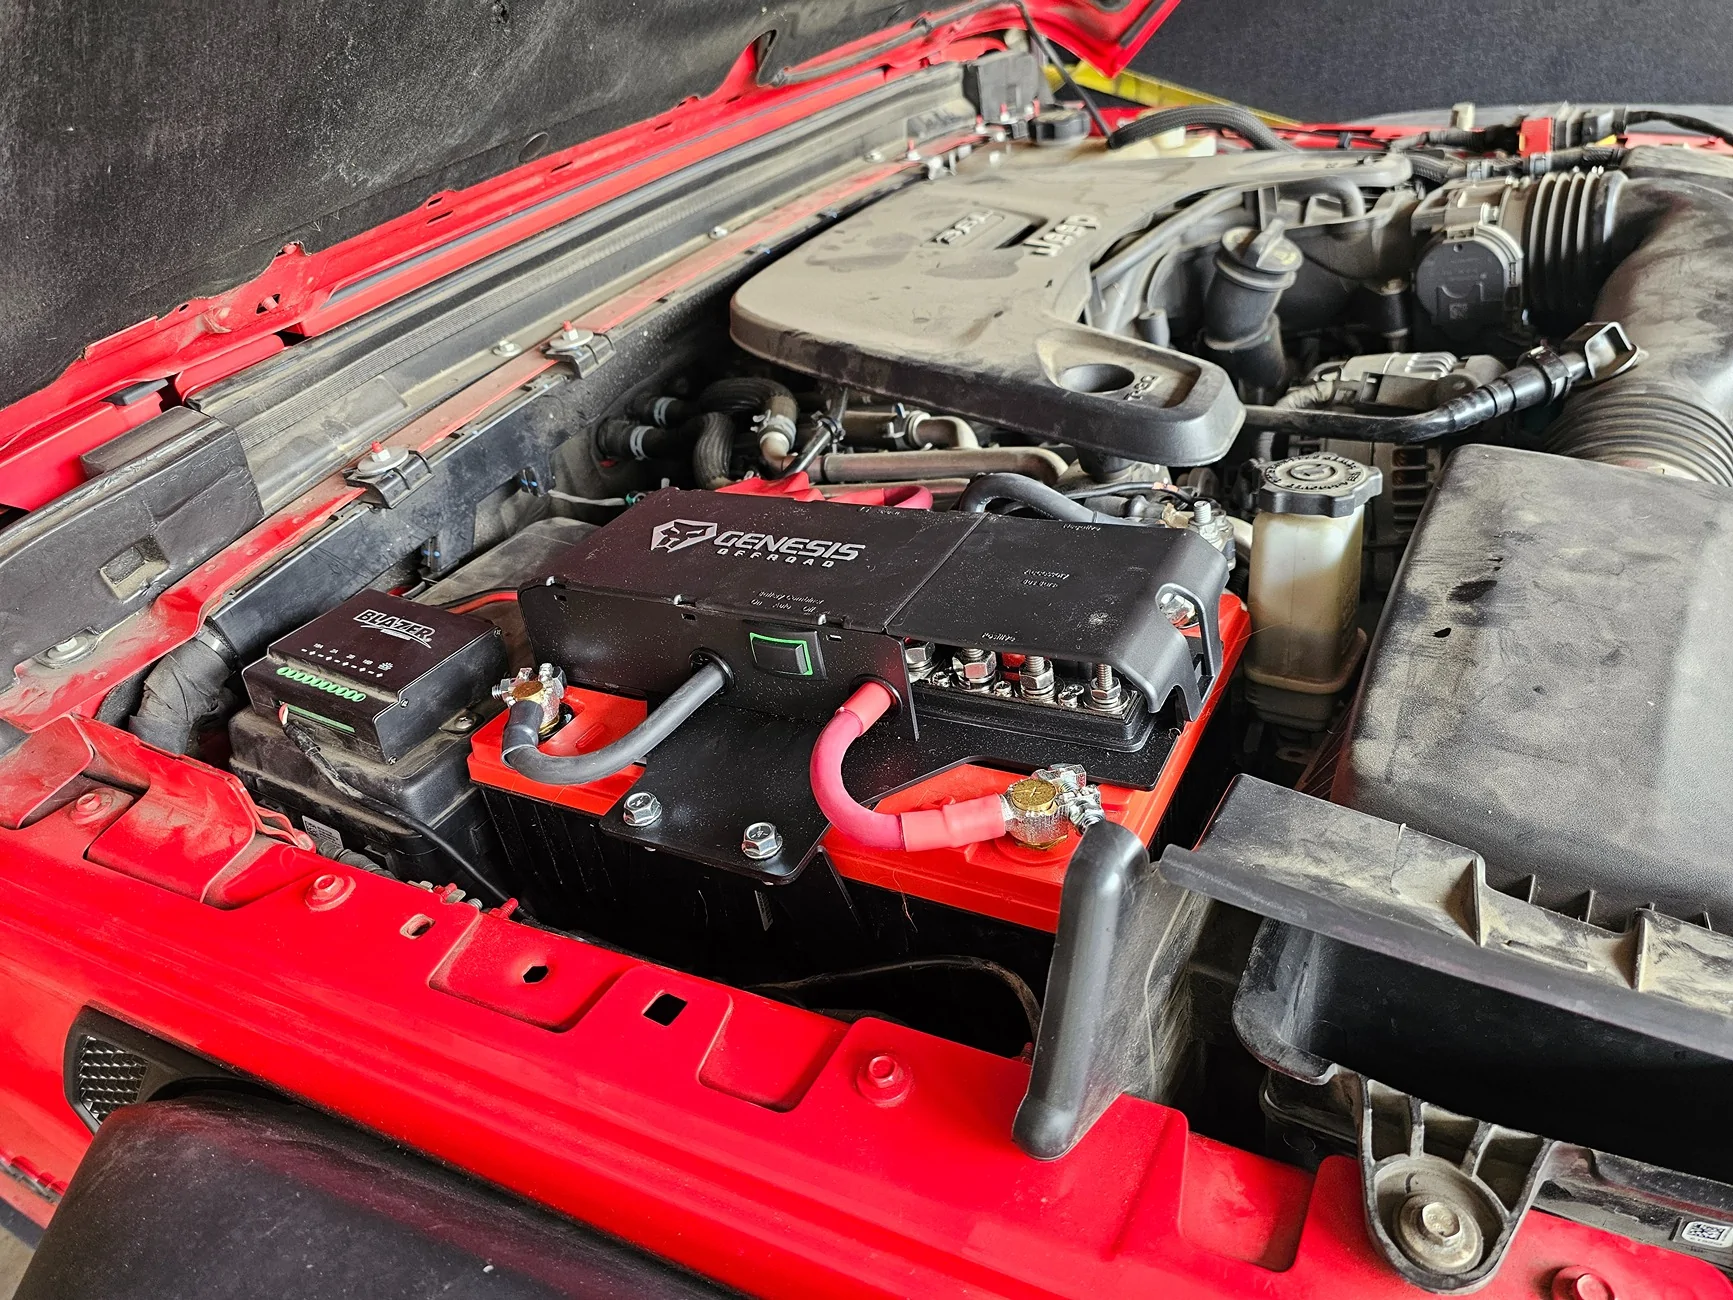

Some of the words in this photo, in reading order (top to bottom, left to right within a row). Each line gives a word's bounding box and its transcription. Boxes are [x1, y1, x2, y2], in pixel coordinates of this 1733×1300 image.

[713, 530, 866, 562] GENESIS
[716, 547, 835, 568] OFFROAD
[1024, 568, 1069, 579] Accessory
[353, 609, 436, 640] BLAZER
